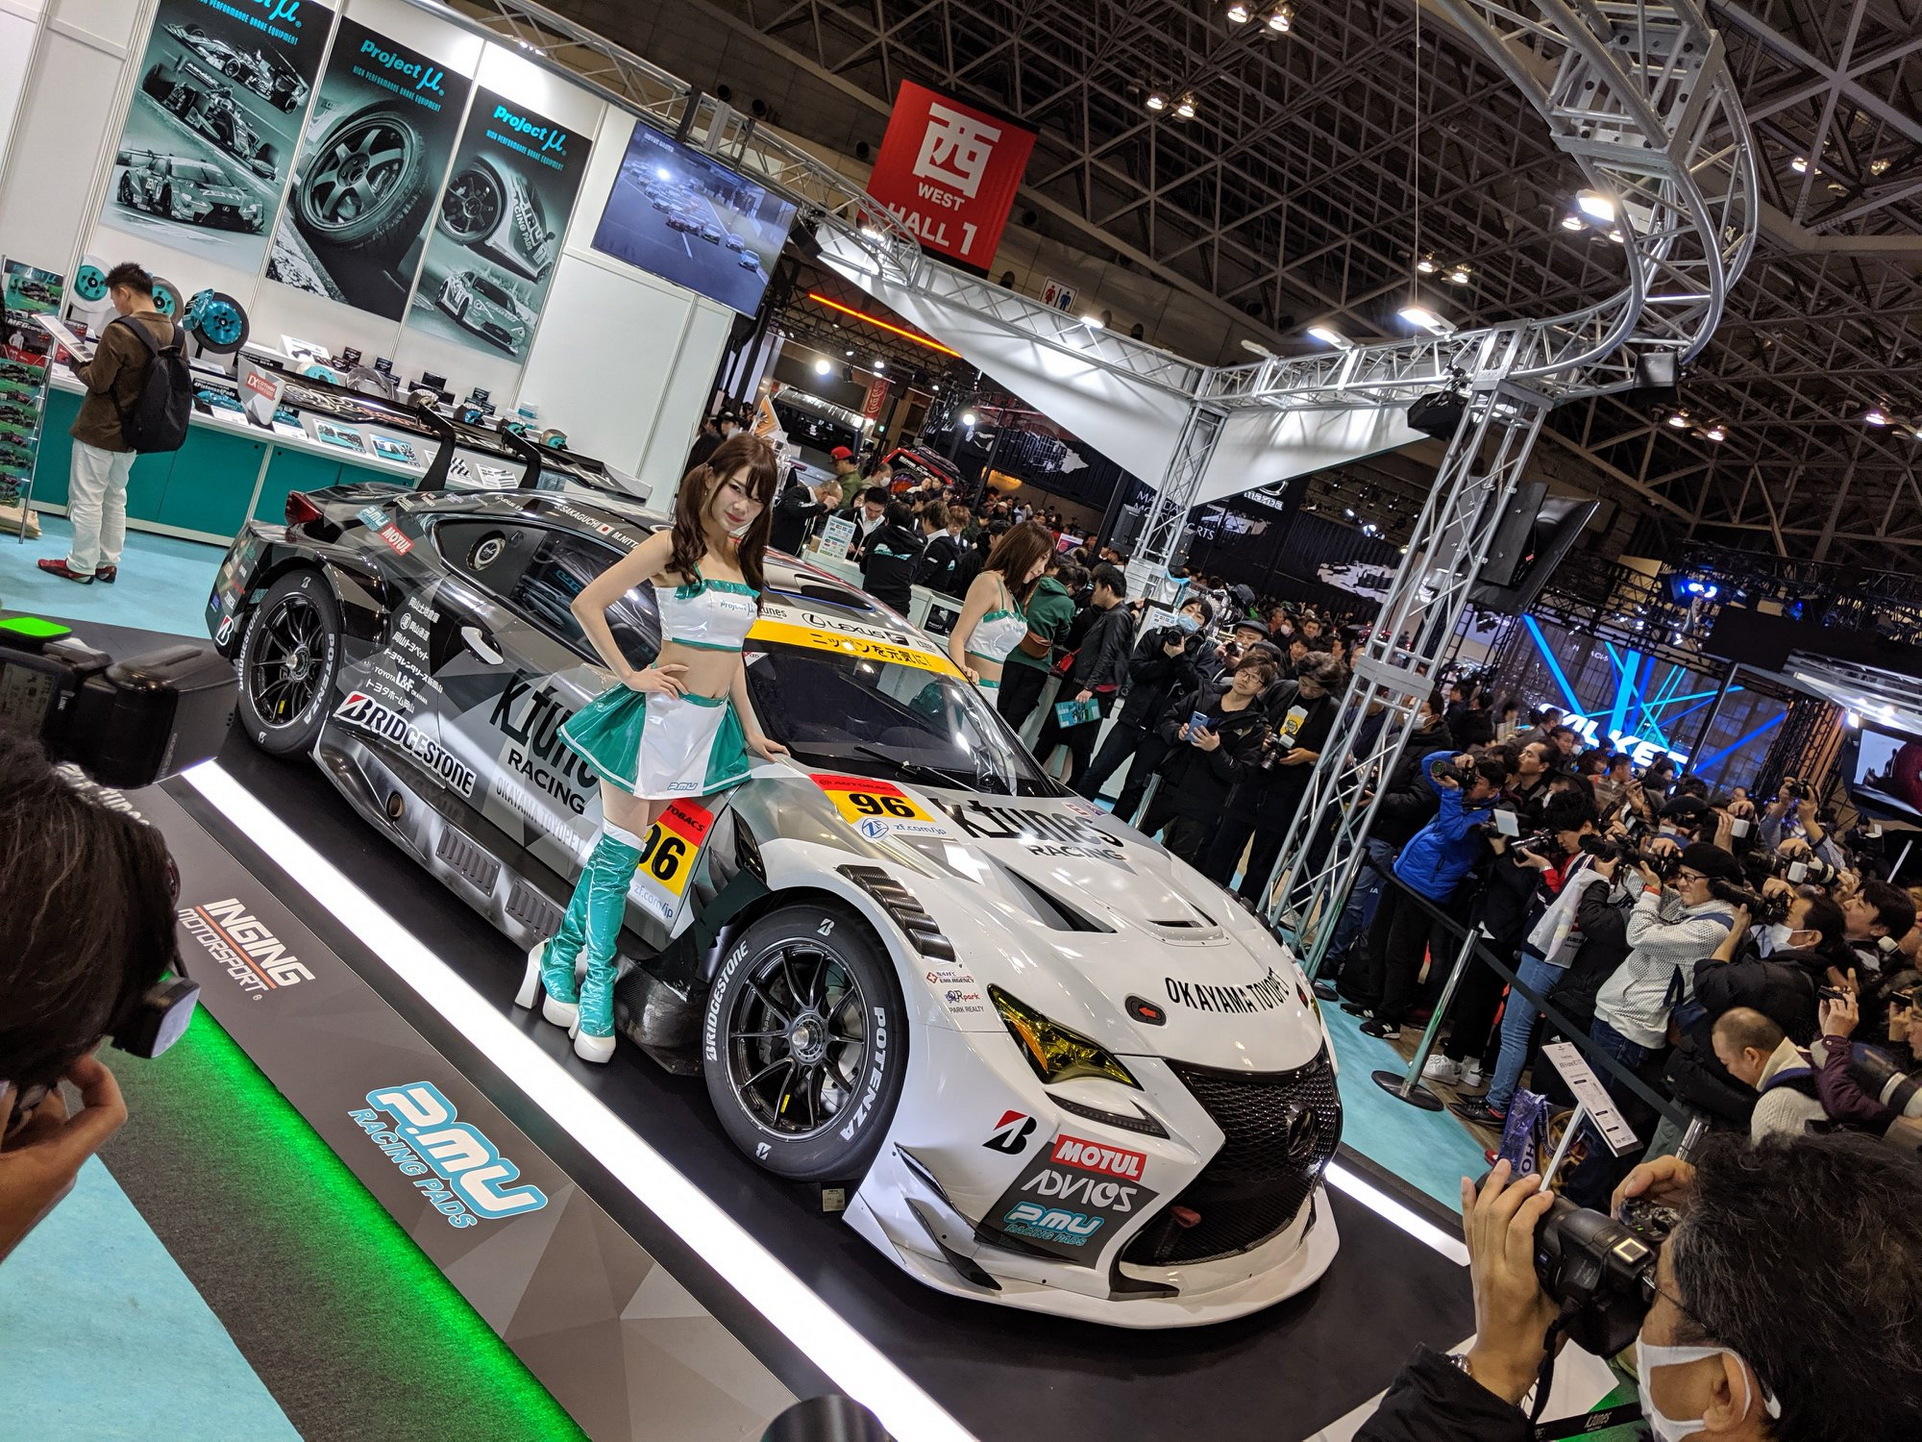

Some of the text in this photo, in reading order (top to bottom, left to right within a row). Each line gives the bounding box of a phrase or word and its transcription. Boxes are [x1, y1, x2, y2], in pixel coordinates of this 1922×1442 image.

[249, 15, 268, 32] BRAKE
[268, 24, 299, 46] EQUIPMENT
[360, 39, 423, 79] Project
[365, 71, 399, 93] PERFORMANCE
[399, 85, 415, 101] BRAKE
[415, 93, 442, 113] EQUIPMENT
[493, 105, 548, 141] Project
[497, 134, 527, 156] PERFORMANCE
[526, 147, 541, 161] BRAKE
[540, 153, 565, 171] EQUIPMENT
[912, 102, 1002, 200] 西
[918, 182, 965, 212] WEST
[885, 202, 978, 256] HALL 1
[554, 504, 601, 529] S.SAKAGUCHI
[1136, 490, 1181, 513] MADA
[380, 527, 413, 554] MOTUL
[391, 631, 429, 661] 岡山トヨペット
[827, 620, 885, 639] LEXUS
[303, 633, 335, 725] POTENZA
[365, 678, 416, 714] トヨタホーム岡山
[374, 666, 396, 683] TOYOTA
[395, 671, 416, 693] L&F
[337, 692, 475, 797] BRIDGESTONE
[507, 748, 586, 816] RACING
[496, 776, 584, 855] OKAYAMA TOYOPET
[666, 805, 705, 832] TOBACS
[848, 792, 916, 818] 96
[893, 822, 948, 836] zf.com/jp
[1028, 843, 1128, 862] RACING
[633, 884, 674, 918] zf.com/jp
[177, 907, 272, 997] MOTORSPORT
[202, 897, 316, 991] INGING
[706, 939, 749, 1062] BRIDGESTONE
[1165, 966, 1290, 1014] OKAYAMA TOYOPET
[949, 1005, 985, 1014] PARK REALTY
[839, 1006, 886, 1142] POTENZA
[347, 1107, 478, 1229] RACING PADS
[1056, 1140, 1141, 1178] MOTUL
[1020, 1169, 1138, 1213] ADVICS
[1004, 1224, 1088, 1247] RACING PADS
